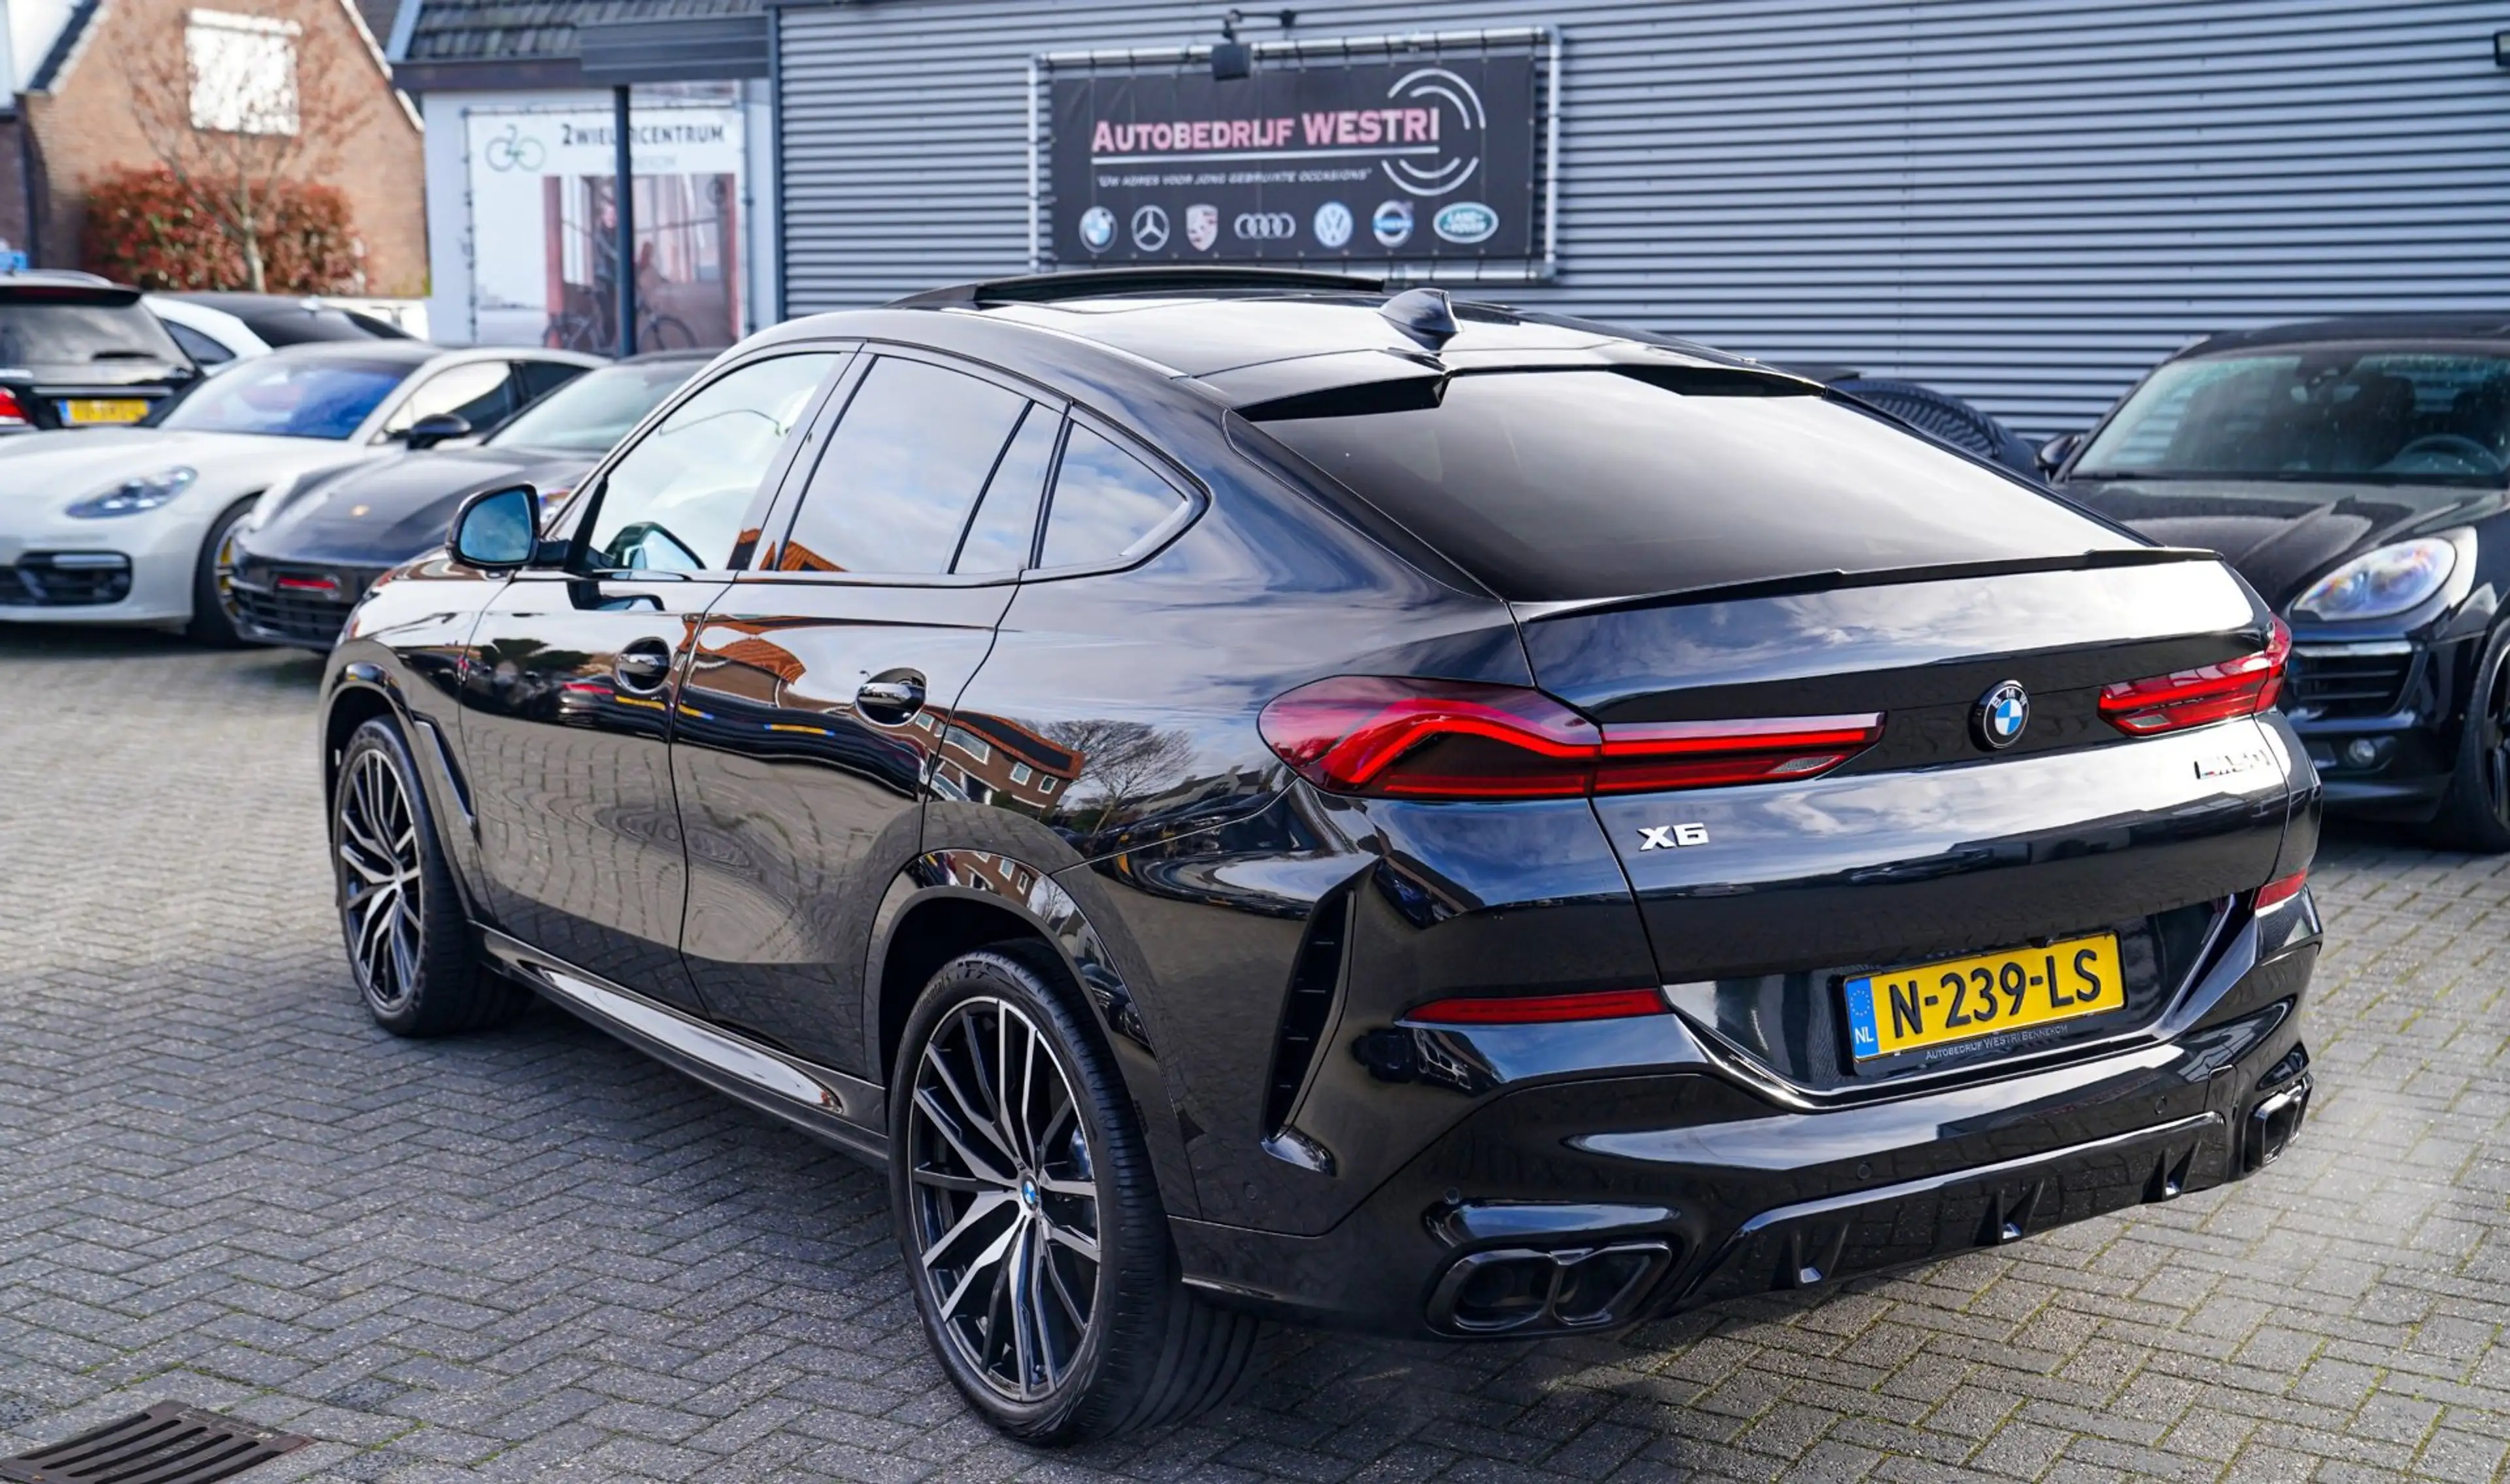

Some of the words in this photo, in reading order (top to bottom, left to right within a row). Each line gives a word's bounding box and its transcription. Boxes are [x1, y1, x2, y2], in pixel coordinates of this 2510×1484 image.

[1091, 118, 1296, 153] AUTOBEDRIJF
[1301, 107, 1440, 146] WESTRI
[1162, 173, 1194, 186] VOOR
[1991, 689, 2028, 708] BMW
[1635, 822, 1709, 851] X6
[1889, 949, 2101, 1038] N-239-LS
[1854, 1026, 1874, 1044] NL
[1925, 1041, 1983, 1061] AUTOBEDRIJF
[1983, 1031, 2020, 1048] WESTRI
[2022, 1025, 2068, 1041] BENNEKOM
